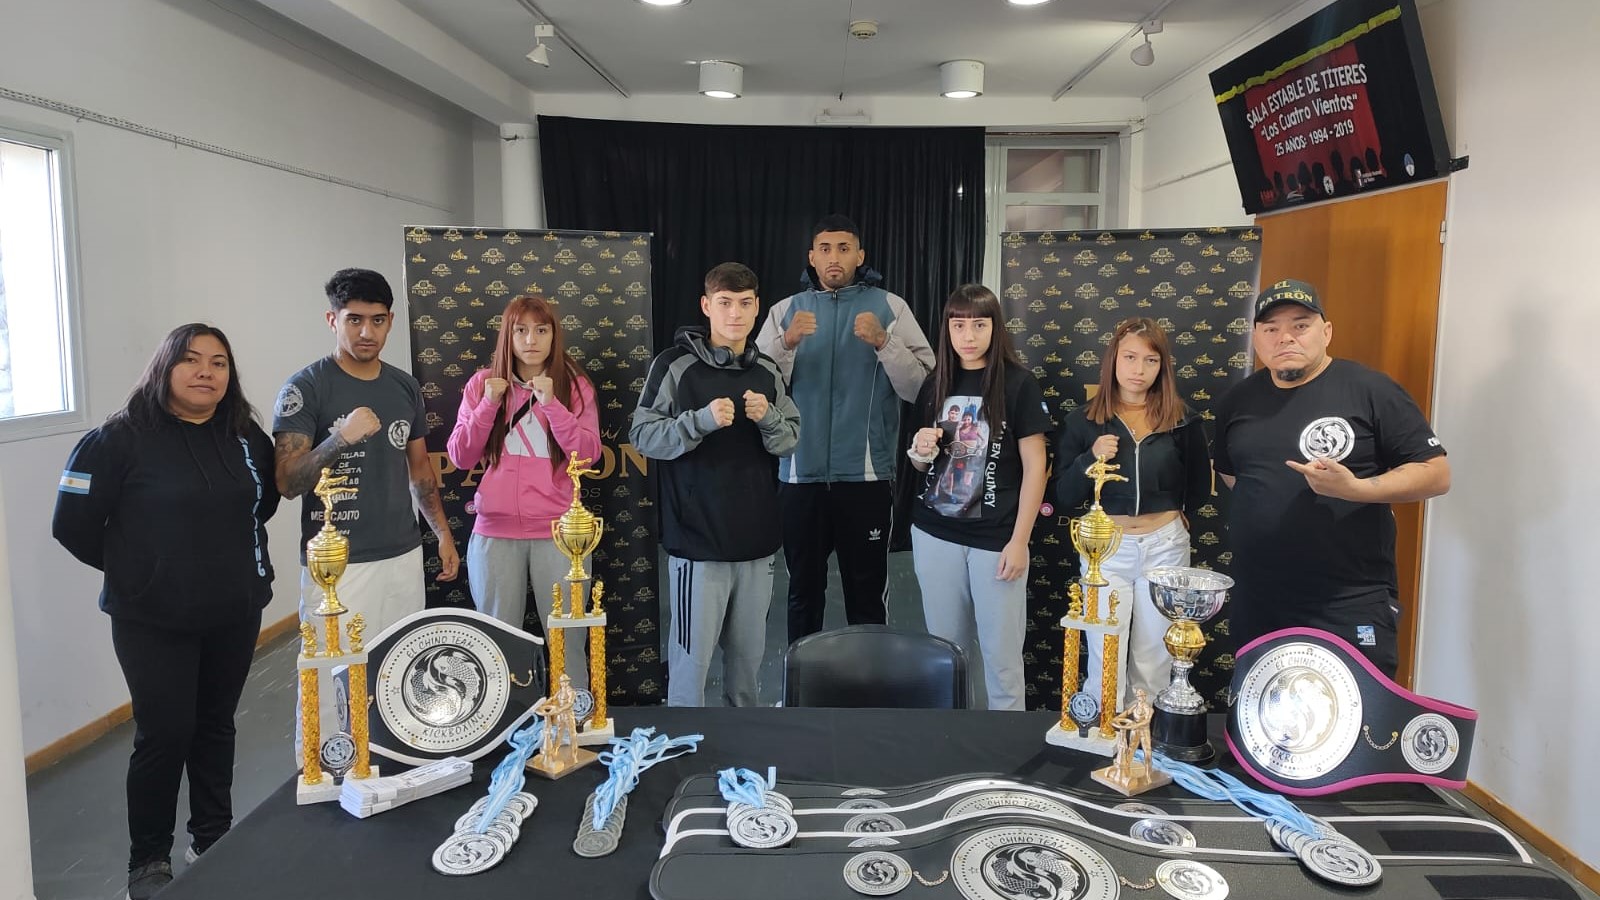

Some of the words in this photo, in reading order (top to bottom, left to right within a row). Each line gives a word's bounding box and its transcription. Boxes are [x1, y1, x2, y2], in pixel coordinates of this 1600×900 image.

[1246, 101, 1269, 129] SALA
[1267, 79, 1306, 113] ESTABLE
[1305, 73, 1320, 94] DE
[1279, 106, 1311, 131] Cuatro
[1275, 142, 1285, 156] 25
[1309, 127, 1329, 145] 1994
[1334, 118, 1354, 138] 2019
[1274, 280, 1290, 290] EL
[311, 510, 360, 520] MECADITO
[406, 648, 418, 659] EL
[419, 635, 448, 650] CHINO
[451, 635, 475, 649] TEAM
[423, 711, 485, 737] KICKBOXING
[988, 799, 1019, 807] CHINO
[985, 841, 998, 850] EL
[1000, 836, 1034, 845] CHINO
